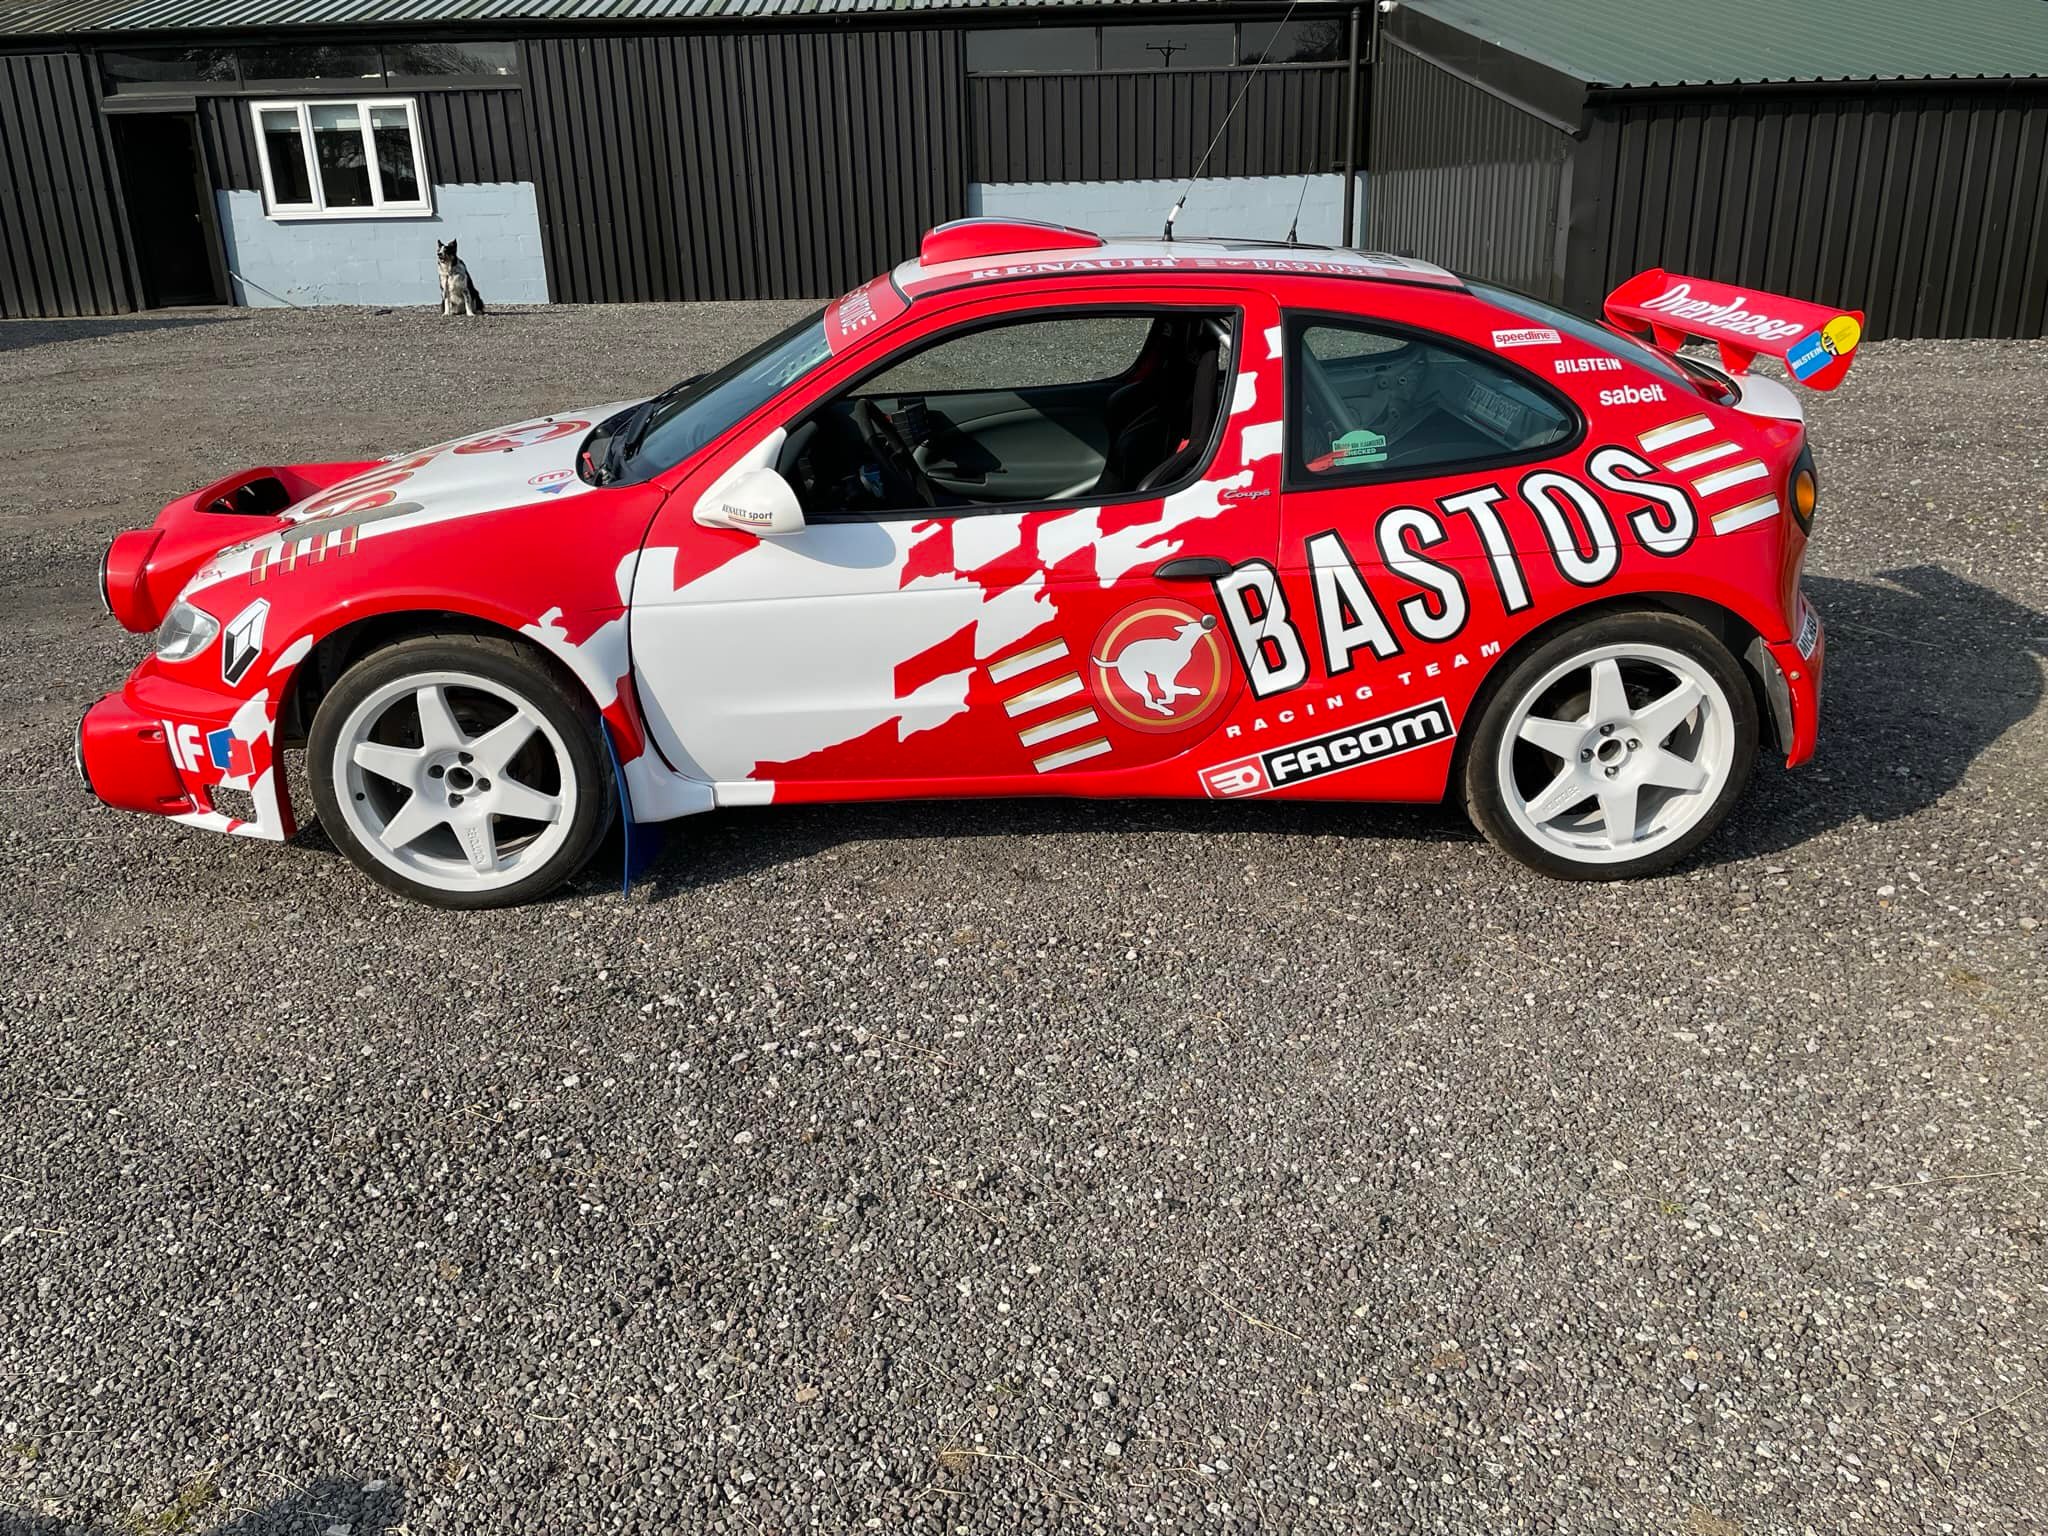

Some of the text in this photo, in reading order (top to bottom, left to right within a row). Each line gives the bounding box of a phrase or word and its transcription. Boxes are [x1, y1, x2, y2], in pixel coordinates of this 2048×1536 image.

[970, 257, 1178, 280] RENAULT
[1252, 259, 1364, 275] BASTOS
[1639, 283, 1805, 341] Overlease
[1495, 331, 1551, 345] speedline
[1554, 358, 1623, 374] BILSTEIN
[1599, 383, 1667, 406] sabelt
[722, 503, 773, 521] RENAULT sport
[1214, 445, 1698, 700] BASTOS
[1226, 641, 1502, 739] RACING TEAM
[1271, 709, 1446, 782] FACOM
